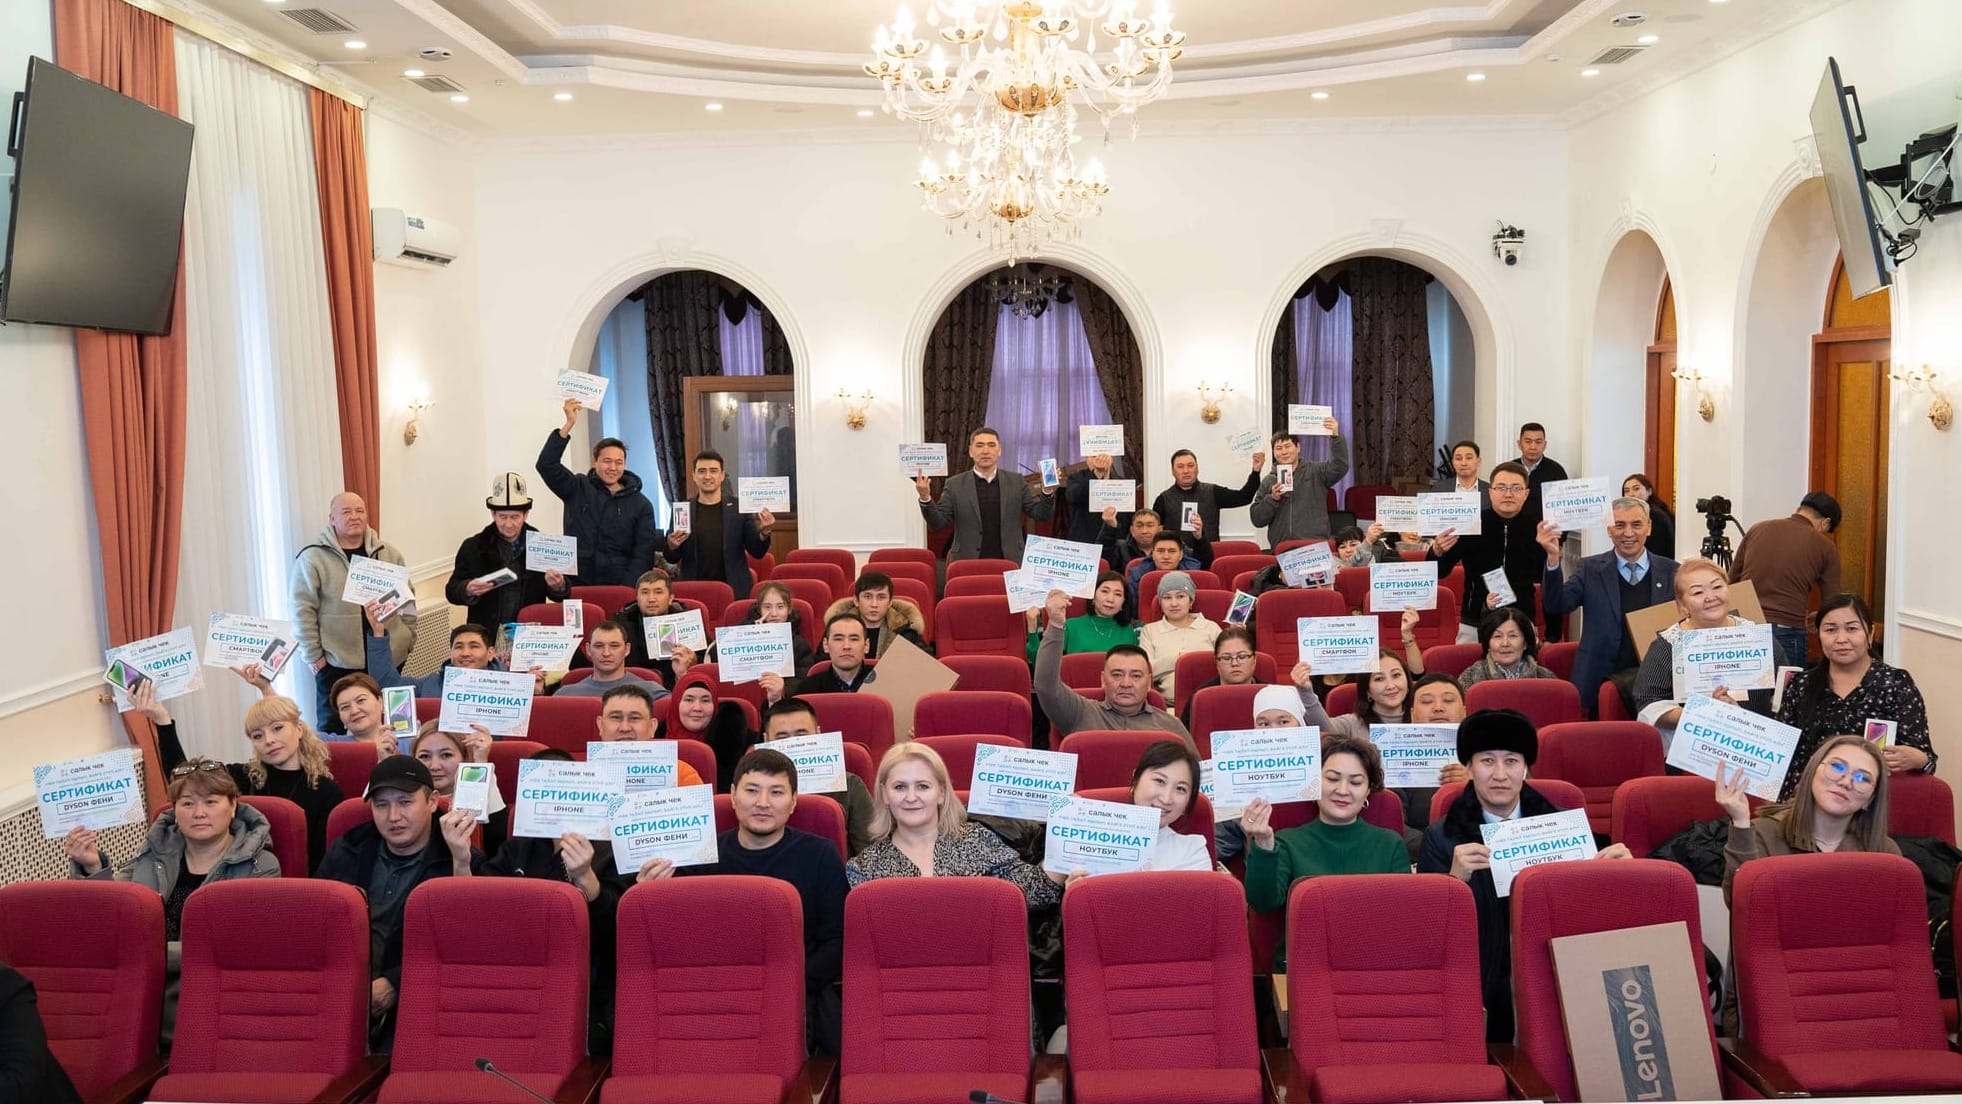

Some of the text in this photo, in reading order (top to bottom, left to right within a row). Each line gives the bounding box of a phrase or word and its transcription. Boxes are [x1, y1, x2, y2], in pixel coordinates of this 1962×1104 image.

[1545, 496, 1607, 509] СЕРТИФИКАТ
[1420, 507, 1478, 516] СЕРТИФИКАТ
[528, 546, 574, 558] СЕРТИФИКАТ
[1026, 555, 1095, 573] СЕРТИФИКАТ
[1284, 554, 1331, 571] СЕРТИФИКАТ
[350, 572, 396, 588] СЕРТИФИК
[1373, 580, 1435, 590] СЕРТИФИКАТ
[516, 642, 569, 650] СЕРТИФИКАТ
[1302, 637, 1375, 647] СЕРТИФИКАТ
[720, 643, 789, 656] СЕРТИФИКАТ
[1687, 648, 1769, 662] СЕРТИФИКАТ
[143, 652, 192, 672] ИФИКАТ
[447, 692, 528, 707] СЕРТИФИКАТ
[1683, 722, 1786, 765] СЕРТИФИКАТ
[1382, 748, 1457, 757] ЕРТИФИКАТ
[1701, 744, 1757, 769] DYSON ФЕНИ
[794, 754, 840, 766] ИФИКАТ
[1217, 756, 1314, 771] СЕРТИФИКАТ
[627, 765, 674, 774] ФИКАТ
[978, 772, 1071, 791] СЕРТИФИКАТ
[1248, 773, 1286, 781] НОУТБУК
[42, 777, 132, 803] СЕРТИФИКАТ
[997, 789, 1048, 799] DYSON ФЕНИ
[64, 796, 114, 811] DYSON ФЕНИ
[615, 815, 709, 836] СЕРТИФИКАТ
[635, 833, 688, 846] DYSON ФЕНИ
[1051, 826, 1150, 847] СЕРТИФИКАТ
[1079, 845, 1118, 856] НОУТБУК
[1493, 835, 1588, 860] СЕРТИФИКАТ
[1525, 854, 1563, 865] НОУТБУК
[1621, 980, 1665, 1101] Lenovo
